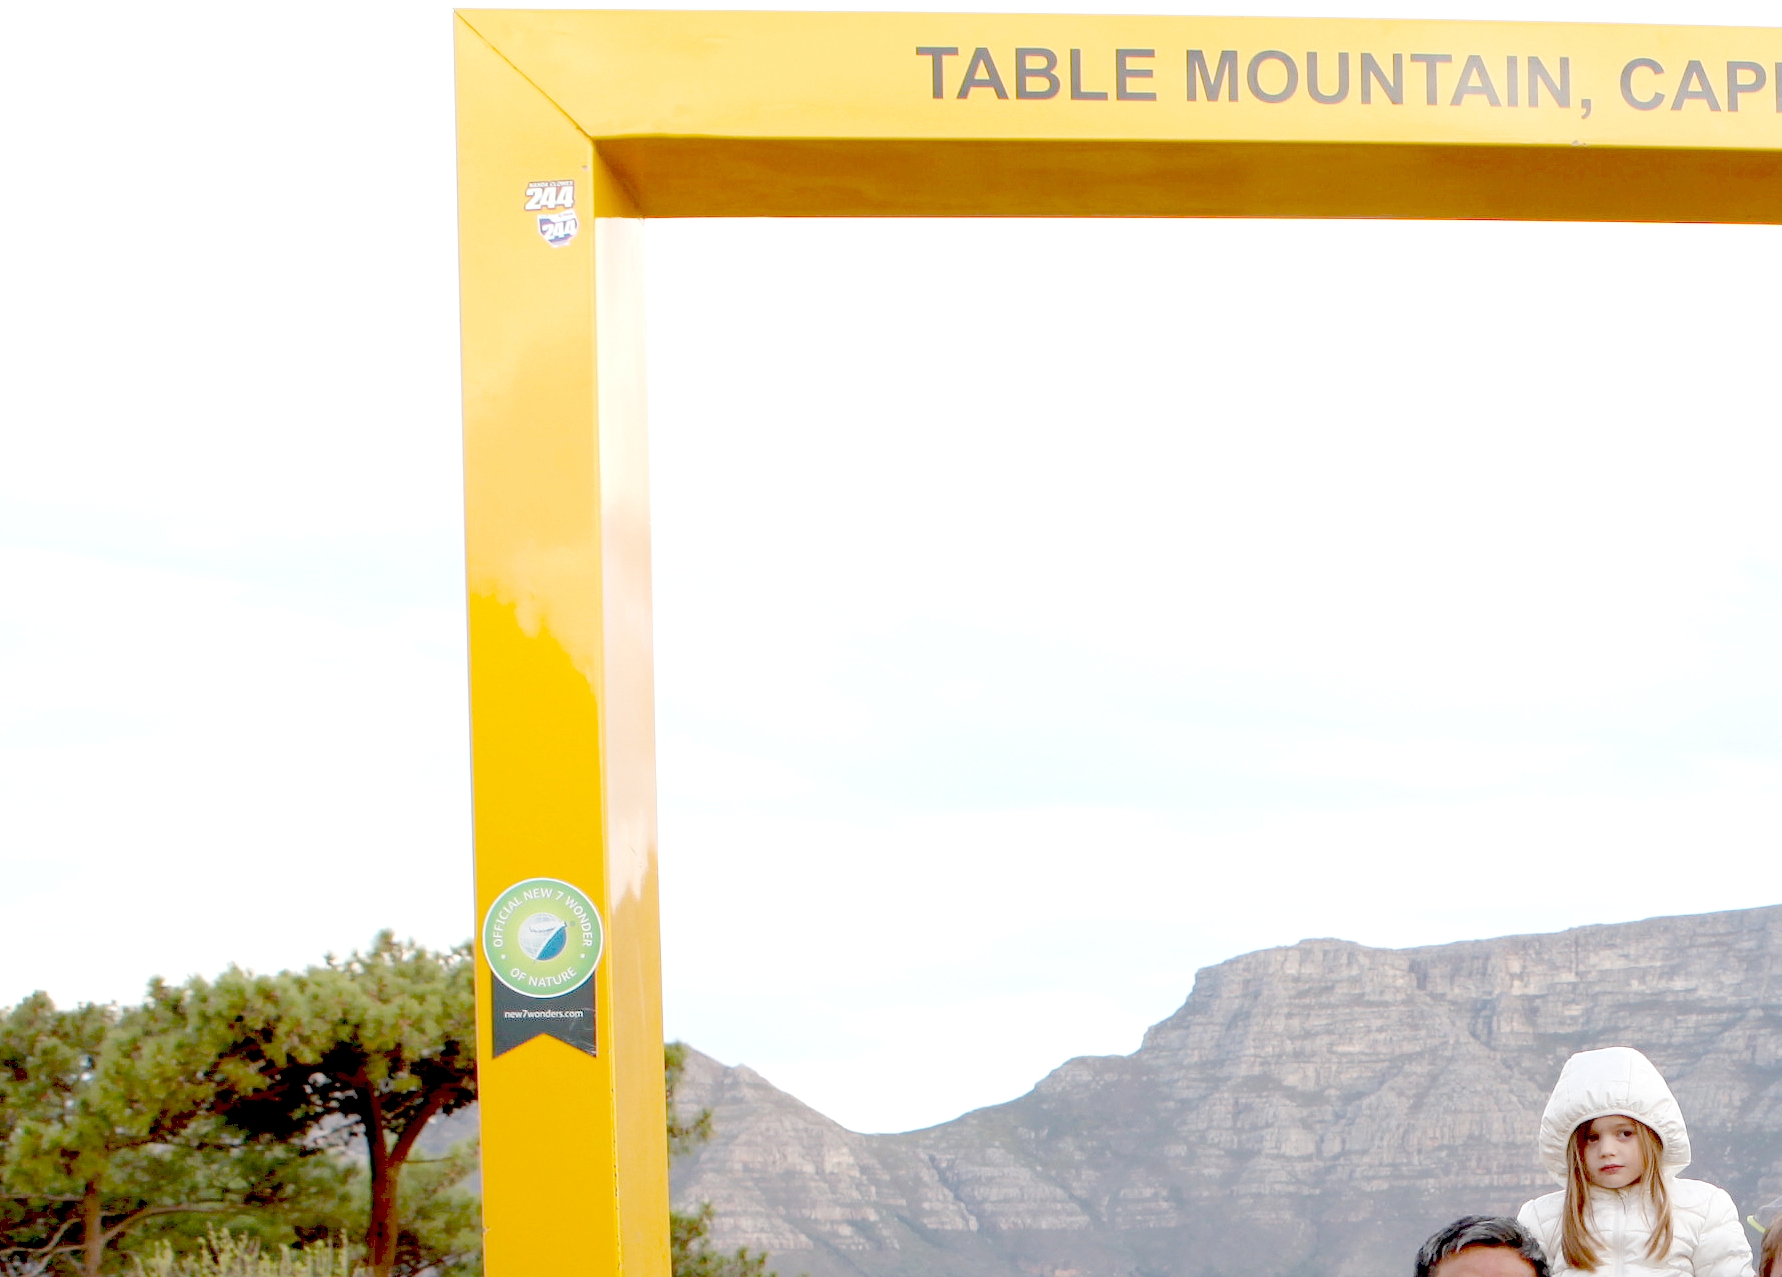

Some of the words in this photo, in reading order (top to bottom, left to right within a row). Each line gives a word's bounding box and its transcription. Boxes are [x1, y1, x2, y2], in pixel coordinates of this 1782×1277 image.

[914, 45, 1157, 102] TABLE
[1185, 49, 1594, 120] MOUNTAIN,
[524, 186, 575, 211] 244
[541, 220, 576, 240] 244
[493, 896, 522, 947] OFFICIAL
[523, 887, 553, 902] NEW
[556, 890, 565, 901] 7
[565, 896, 593, 947] WONDER
[509, 967, 527, 982] OF
[528, 966, 578, 988] NATURE
[503, 1009, 584, 1020] new7wonders.com
